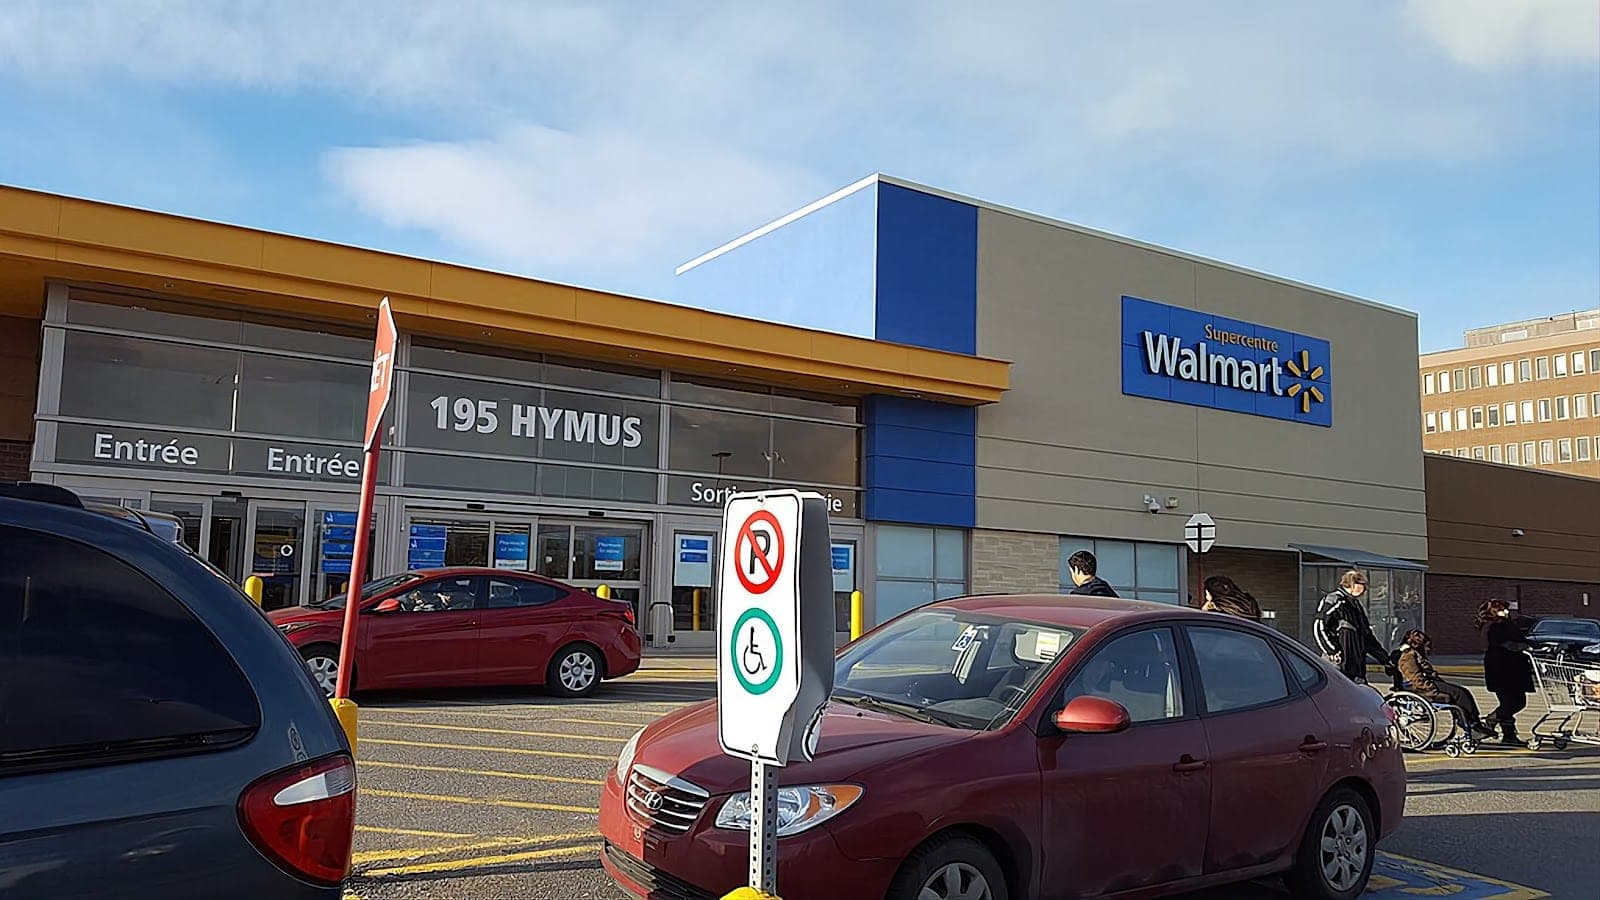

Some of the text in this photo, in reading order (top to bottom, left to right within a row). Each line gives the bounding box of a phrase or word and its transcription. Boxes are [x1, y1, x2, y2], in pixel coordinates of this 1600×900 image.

[1204, 323, 1280, 353] Supercentre
[1143, 330, 1284, 396] Walmart
[430, 396, 643, 448] 195 HYMUS
[93, 432, 199, 466] Entrée
[266, 447, 361, 478] Entrée
